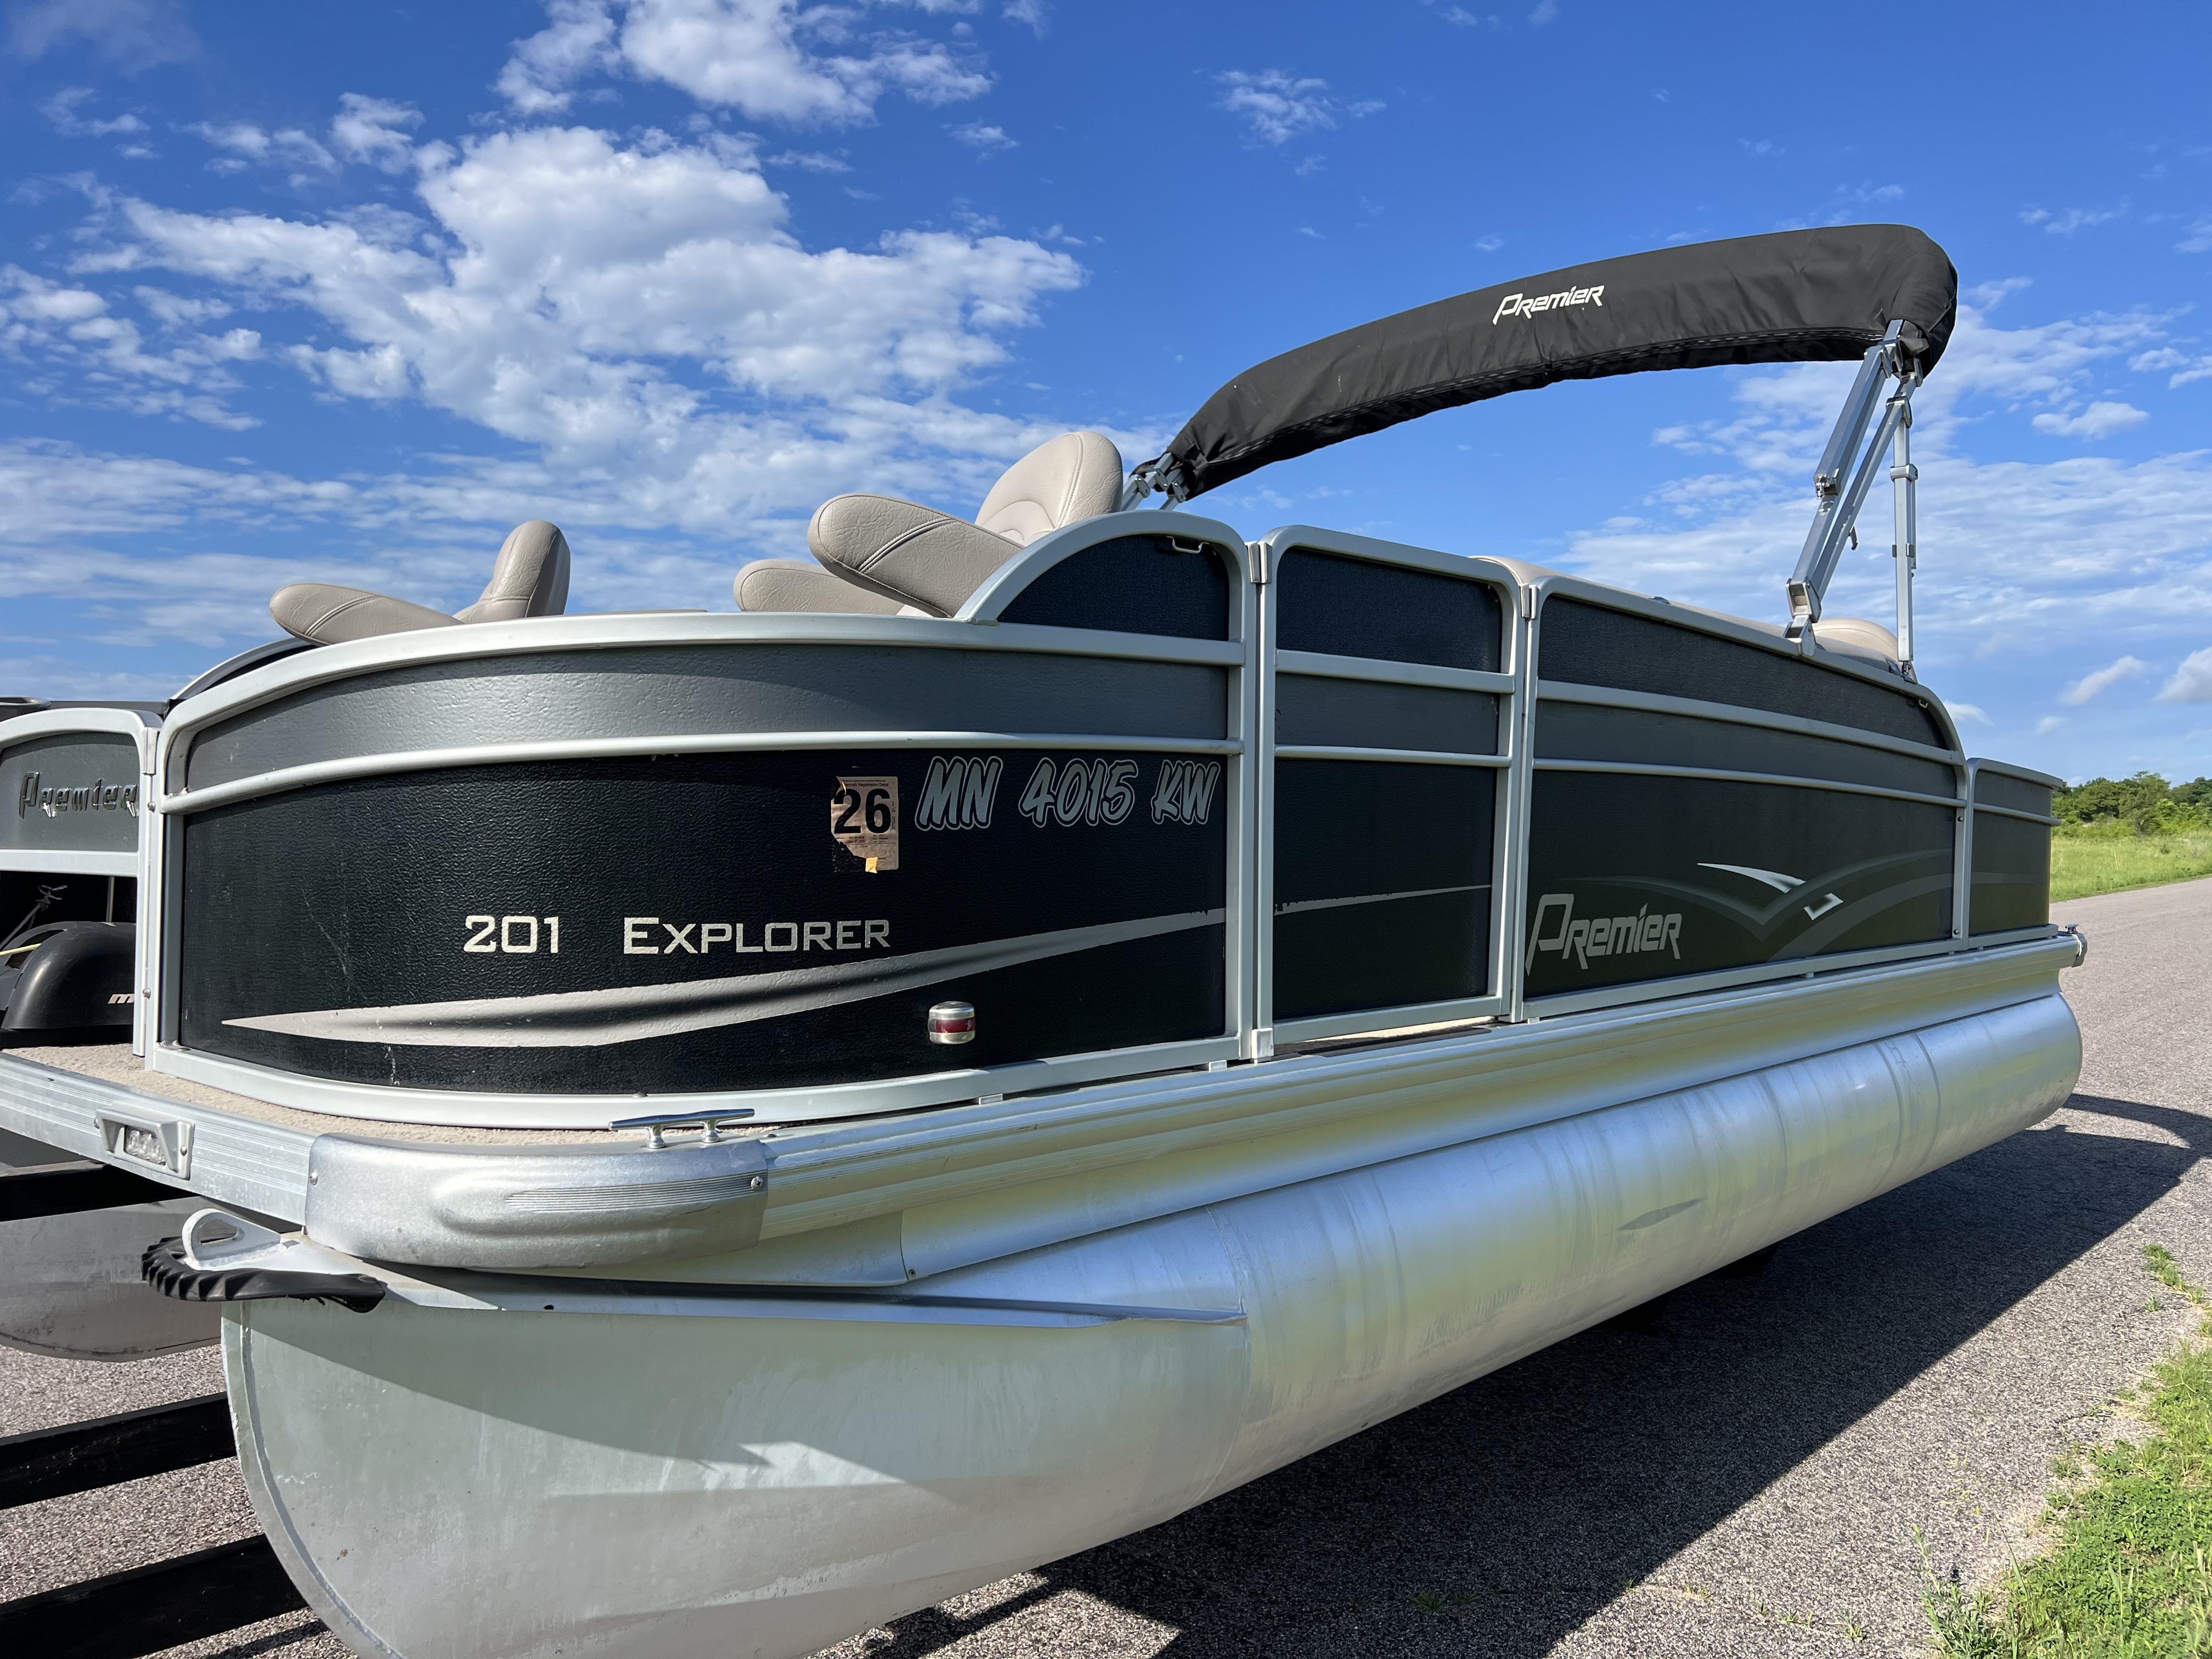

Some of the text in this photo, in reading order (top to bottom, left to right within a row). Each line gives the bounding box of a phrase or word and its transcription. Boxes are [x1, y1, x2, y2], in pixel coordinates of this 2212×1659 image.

[1492, 285, 1605, 325] Premier
[19, 771, 138, 819] Premier
[833, 788, 891, 834] 26
[915, 756, 1003, 832] MN
[1018, 757, 1139, 828] 4015
[1152, 759, 1221, 825] KW
[464, 915, 891, 954] 201 EXPLORER
[1525, 893, 1683, 977] Premier
